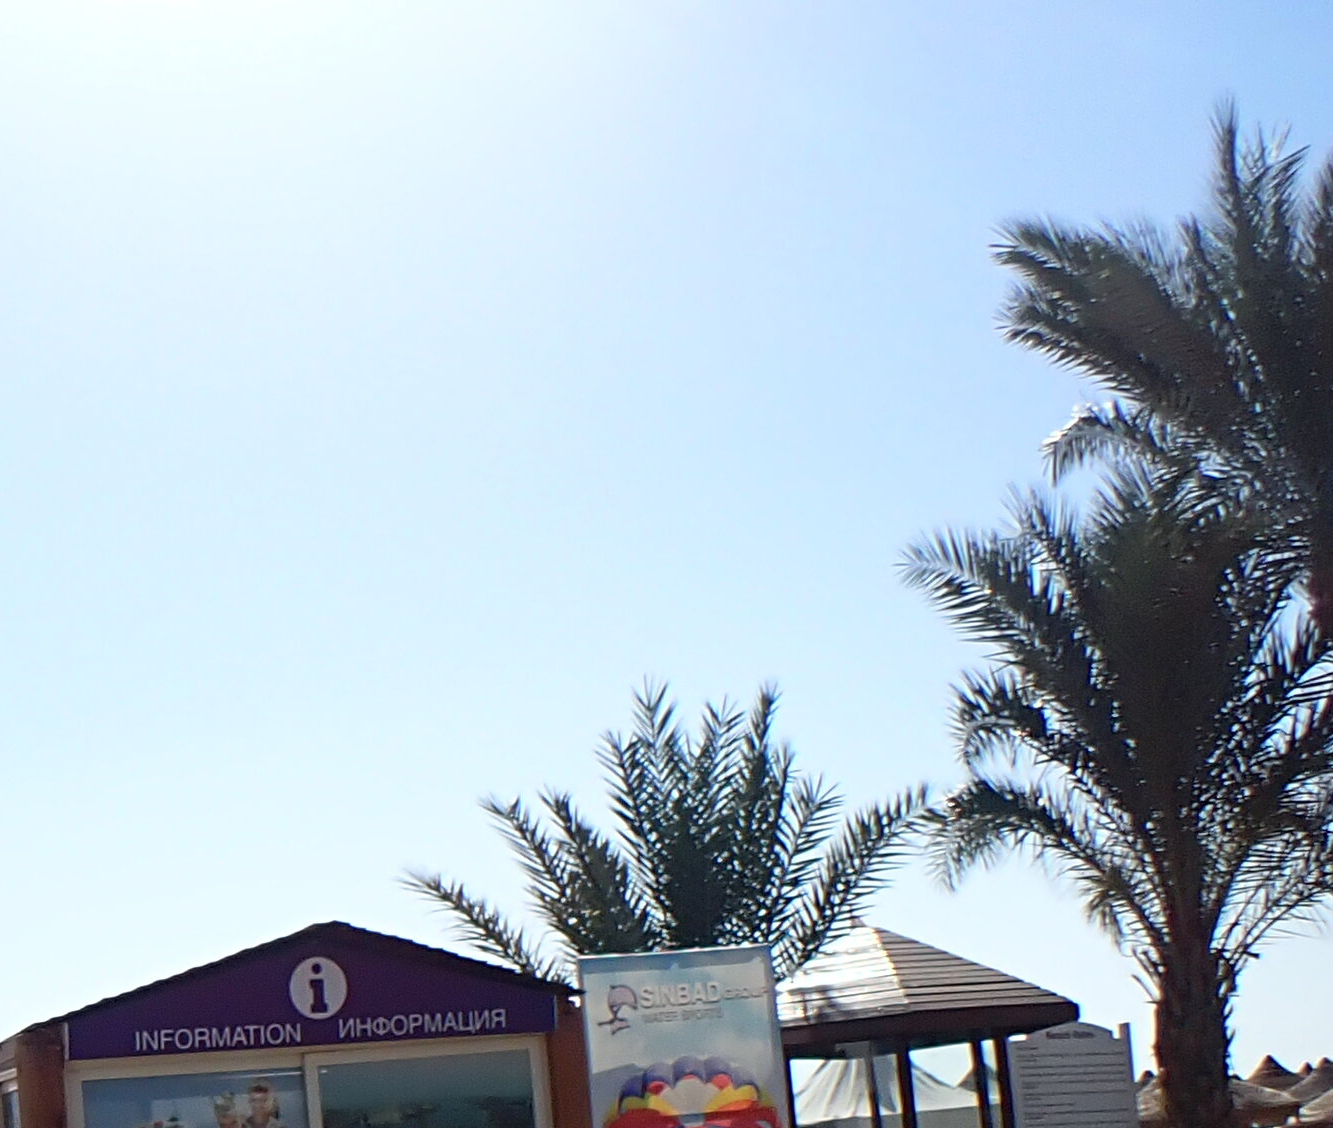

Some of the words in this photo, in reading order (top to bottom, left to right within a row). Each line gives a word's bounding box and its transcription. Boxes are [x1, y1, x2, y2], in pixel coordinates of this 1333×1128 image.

[640, 981, 721, 1009] SINBAD
[135, 1022, 302, 1052] INFORMATION
[339, 1008, 507, 1039] ИНФОРМАЦИЯ
